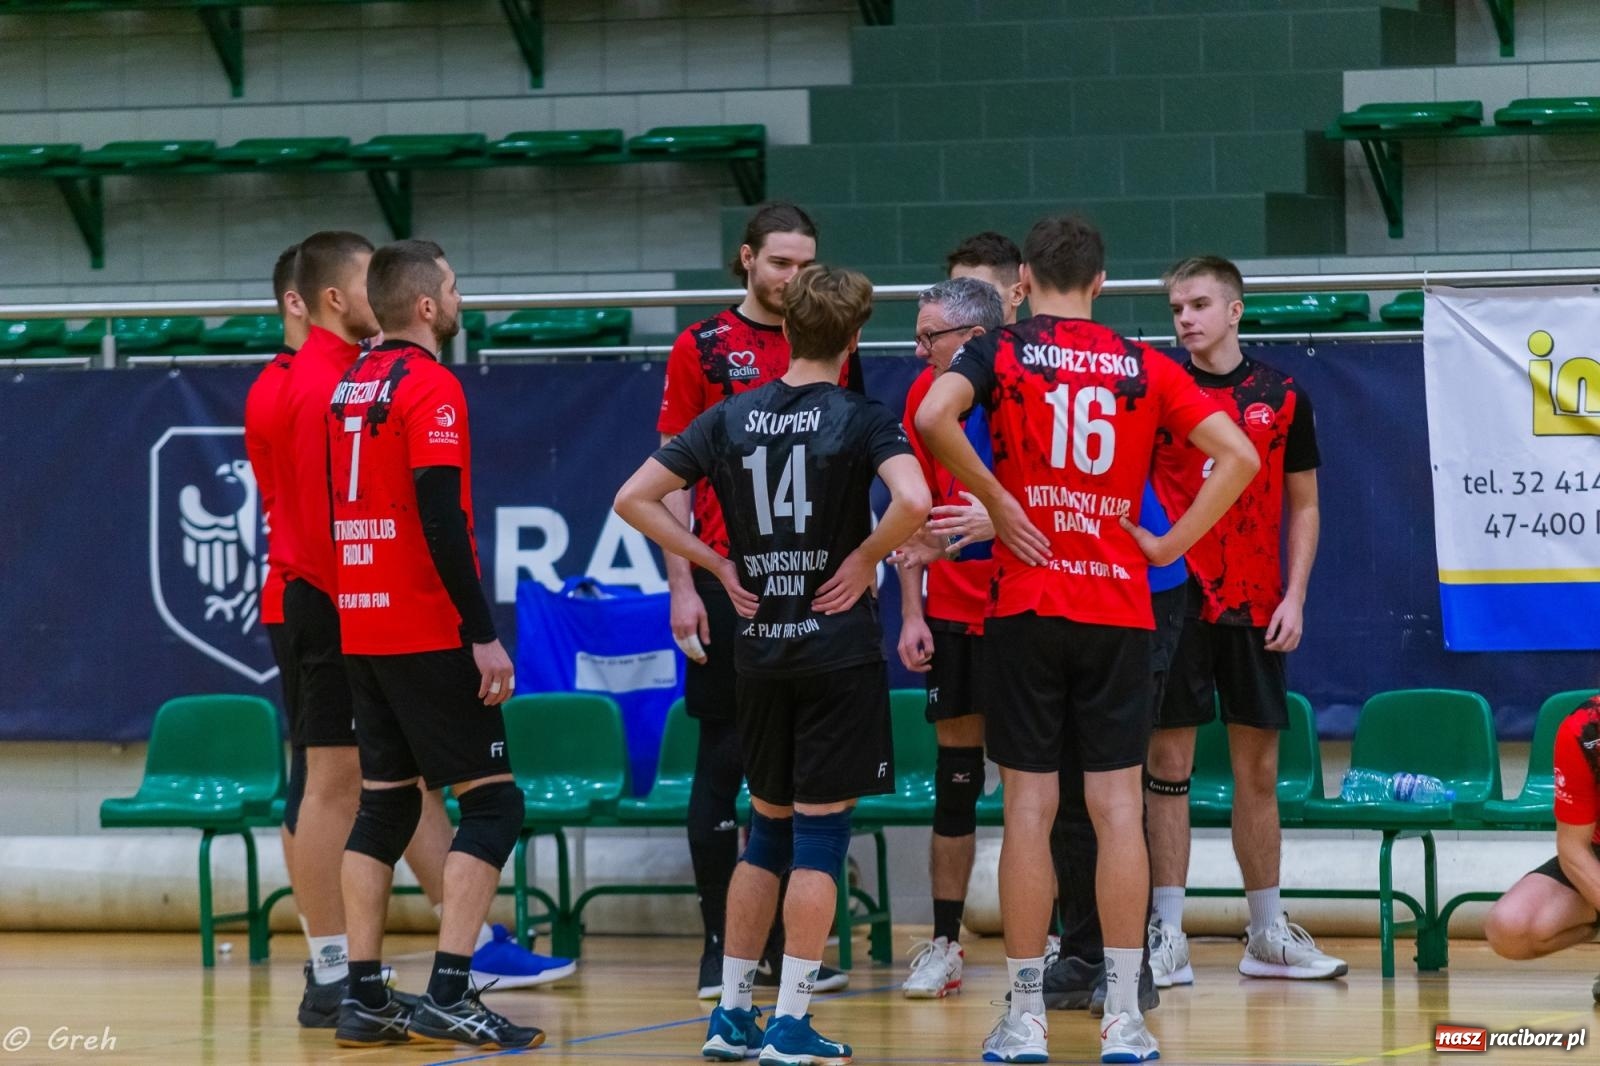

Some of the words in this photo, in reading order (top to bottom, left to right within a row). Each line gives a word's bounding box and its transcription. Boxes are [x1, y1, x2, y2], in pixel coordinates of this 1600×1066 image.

[729, 365, 760, 377] radlin
[1022, 343, 1139, 377] SKORZYSKO
[428, 430, 459, 439] POLSKA
[745, 407, 821, 435] SKUPIEŃ
[1045, 383, 1117, 476] 16
[344, 416, 363, 502] 7
[742, 444, 813, 535] 14
[1463, 469, 1503, 495] tel.
[1512, 471, 1544, 496] 32
[1484, 512, 1585, 539] 47-400
[758, 623, 782, 638] PLAY
[797, 618, 820, 636] FUN
